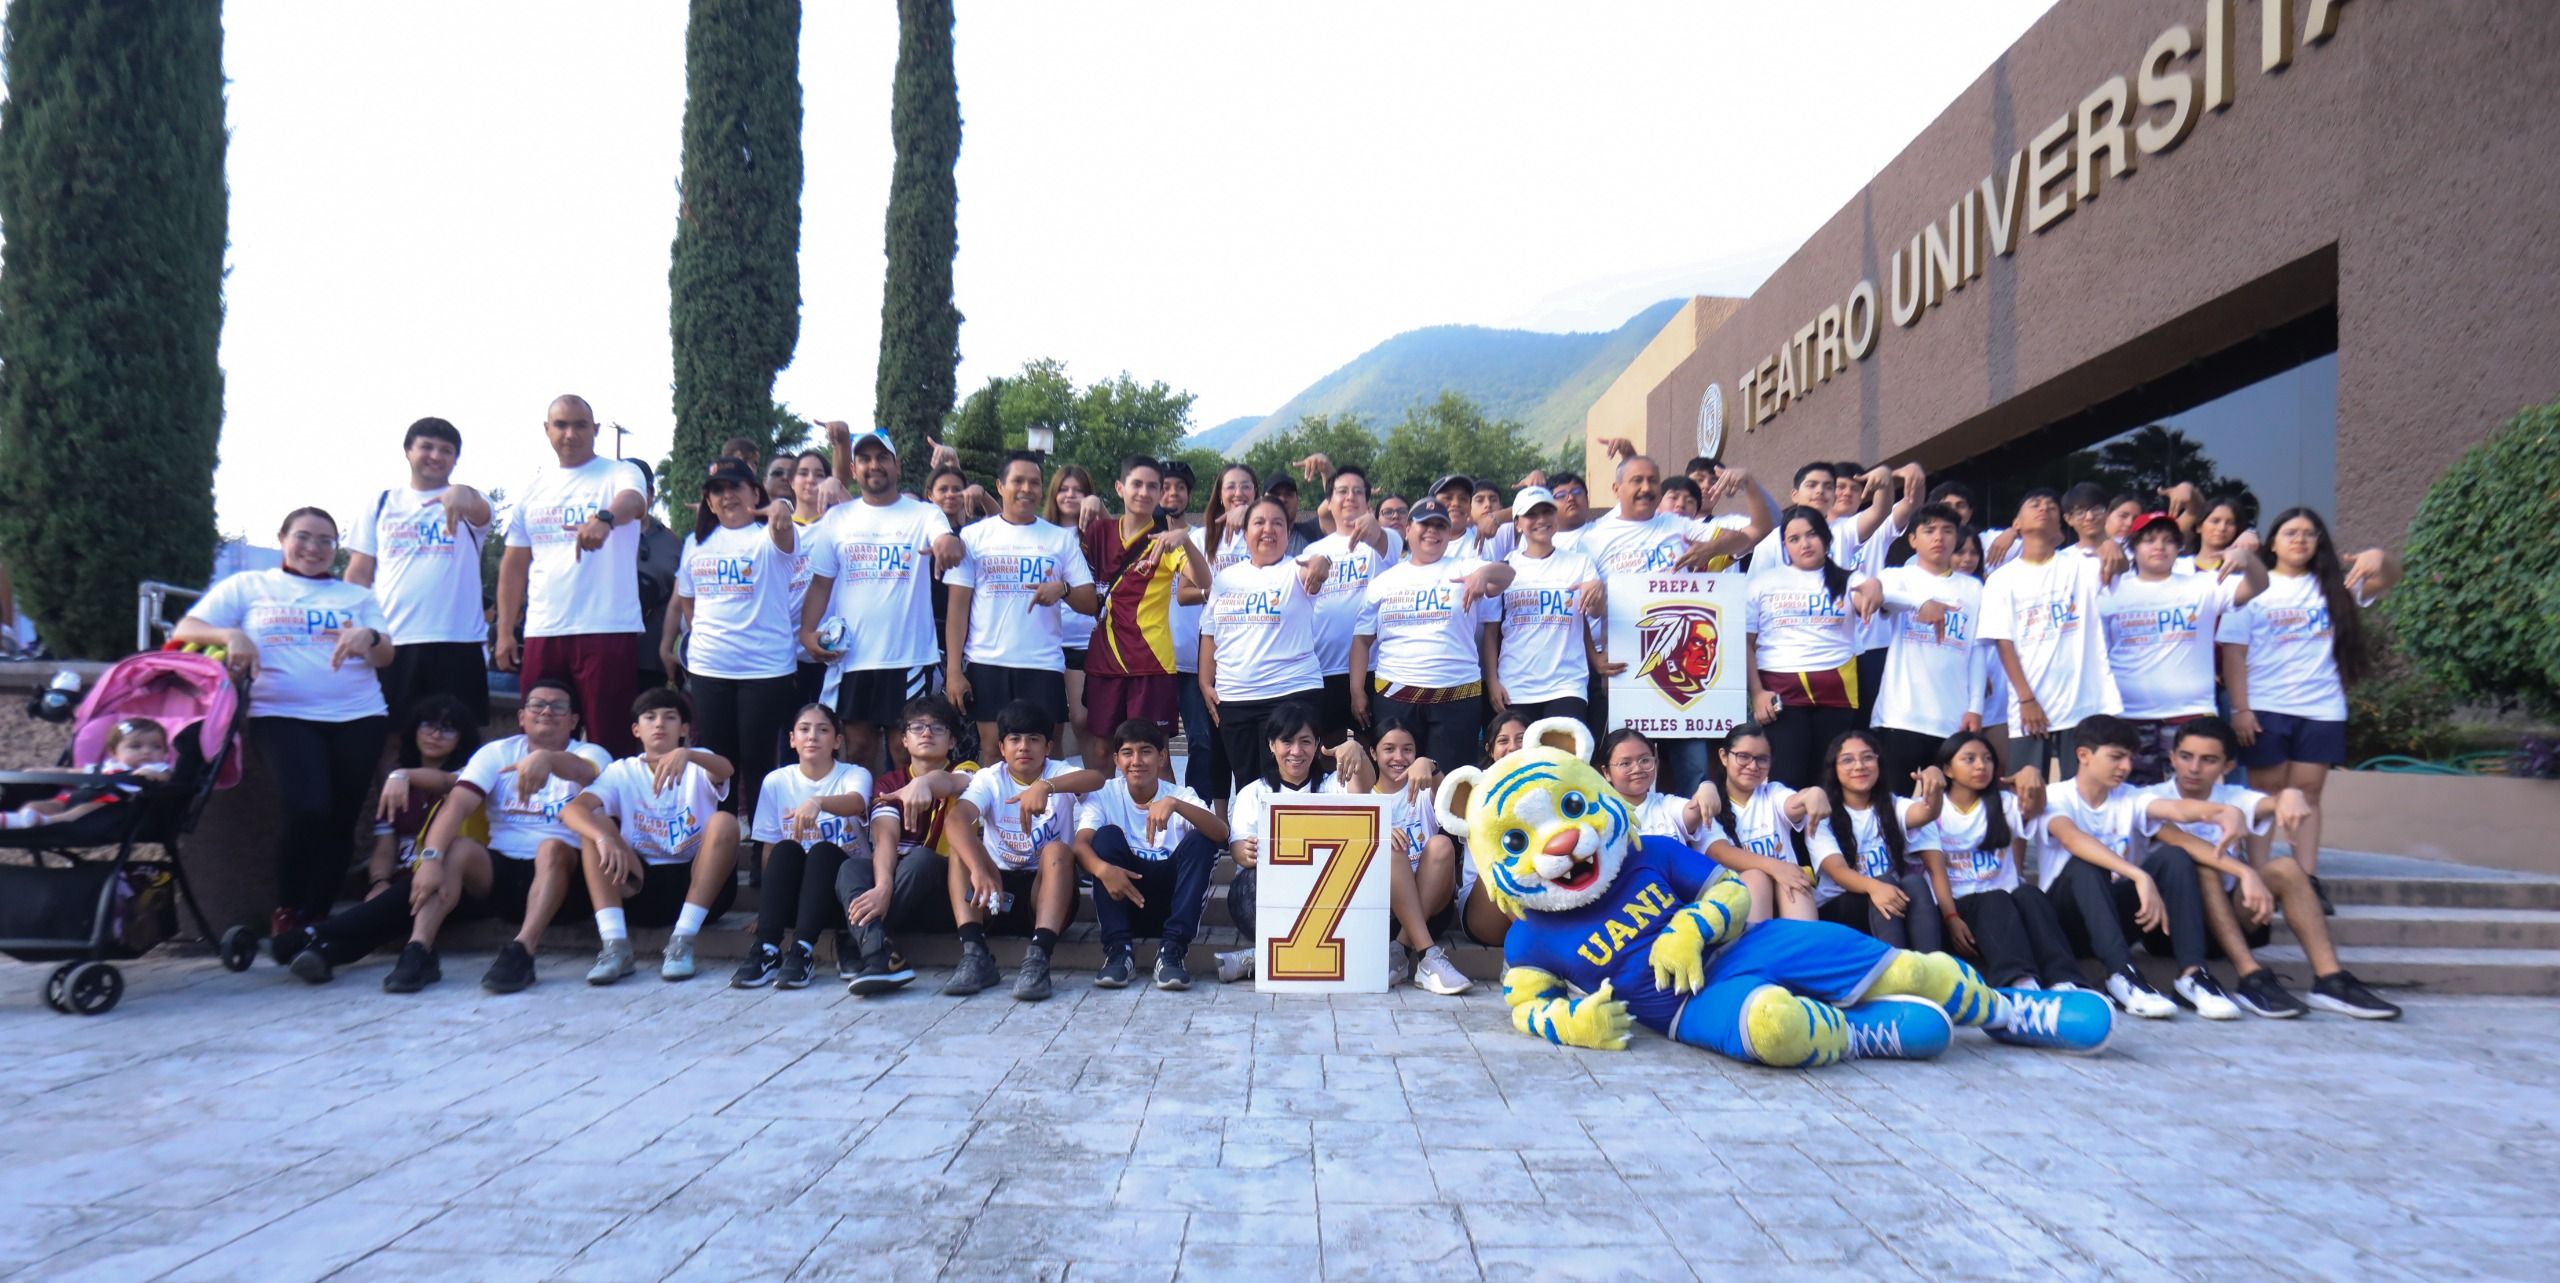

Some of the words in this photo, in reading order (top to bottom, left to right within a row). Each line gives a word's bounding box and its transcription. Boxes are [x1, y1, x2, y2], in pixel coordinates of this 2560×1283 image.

[1738, 279, 1881, 431] TEATRO
[1891, 0, 2340, 327] UNIVERSI
[879, 545, 911, 570] PAZ
[718, 559, 754, 585] PAZ
[1415, 586, 1452, 611] PAZ
[1649, 580, 1700, 593] PREPA
[1707, 580, 1716, 592] 7
[1246, 591, 1281, 614] PAZ
[1540, 589, 1574, 616] PAZ
[2158, 605, 2197, 633] PAZ
[1625, 719, 1678, 732] PIELES
[1686, 719, 1733, 731] ROJAS
[1268, 805, 1380, 981] 7
[1577, 882, 1676, 967] UANL
